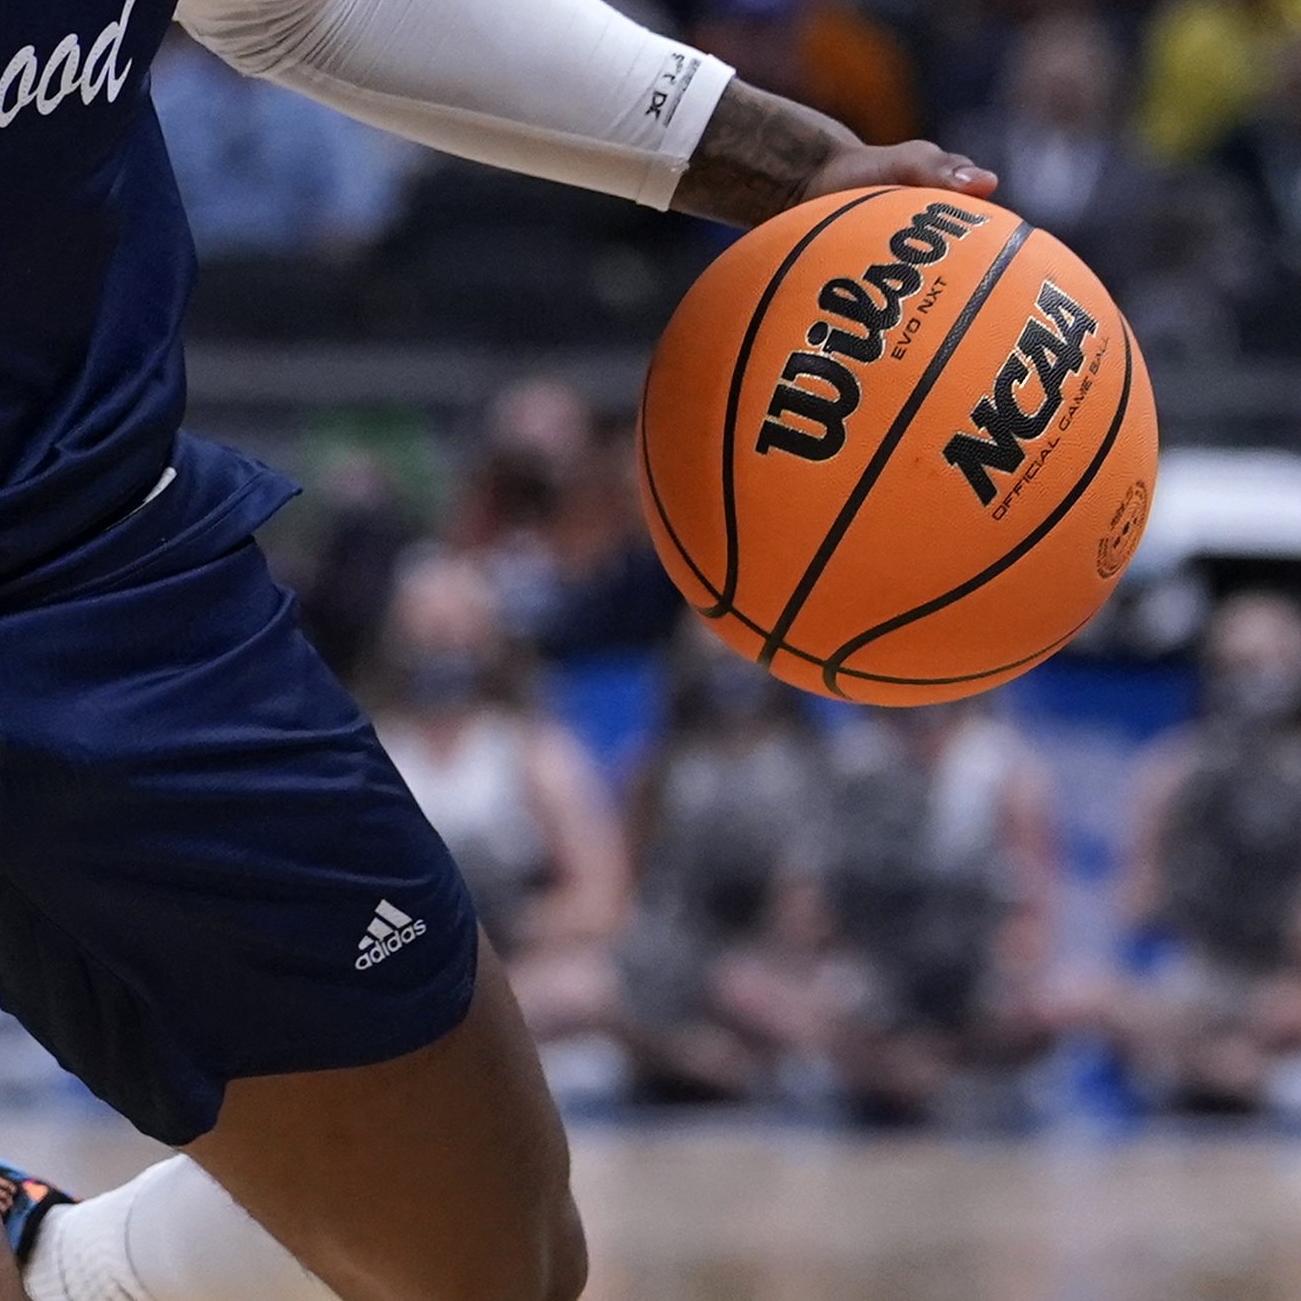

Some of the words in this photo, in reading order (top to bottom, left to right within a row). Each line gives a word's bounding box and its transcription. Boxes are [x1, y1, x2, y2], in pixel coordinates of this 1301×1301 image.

[754, 201, 991, 464] Wilson
[890, 317, 922, 361] EVO
[916, 276, 948, 315] NXT
[941, 278, 1100, 508] NCAA
[992, 436, 1061, 521] OFFICIAL
[1058, 376, 1092, 432] GAME
[1089, 336, 1111, 376] BALL
[354, 918, 427, 971] adidas
